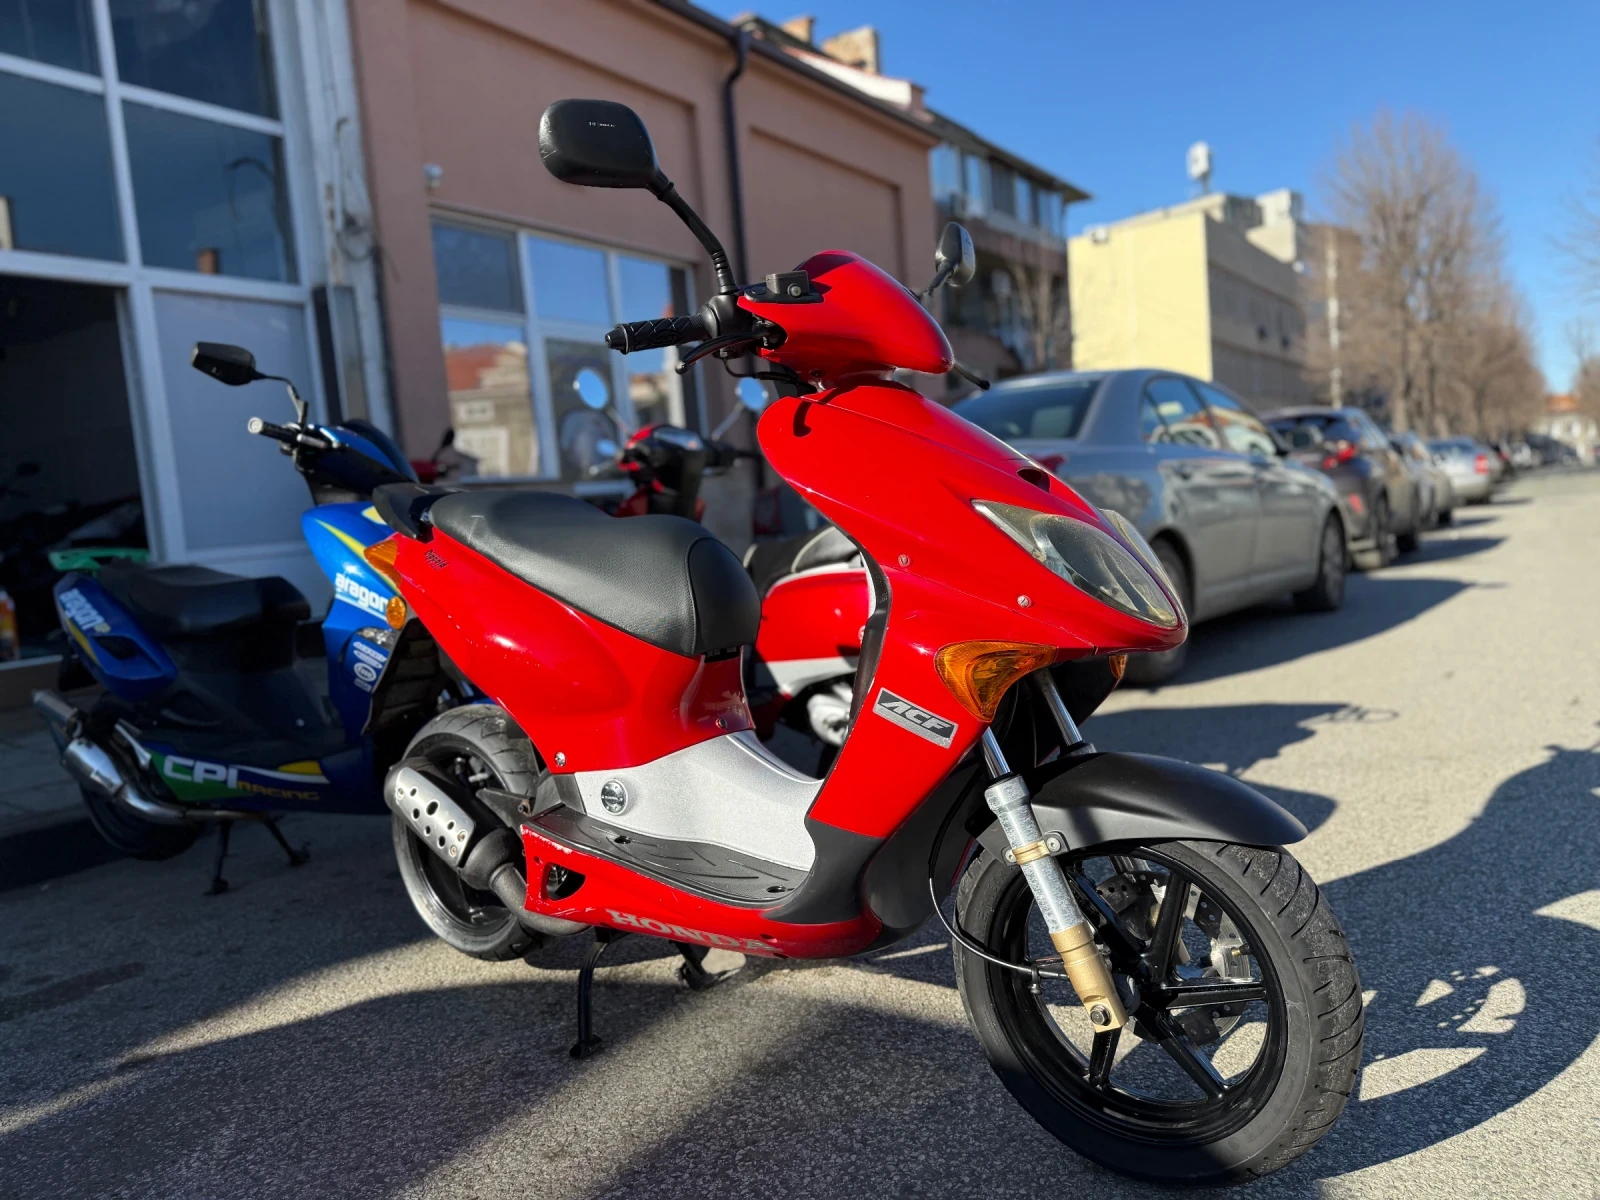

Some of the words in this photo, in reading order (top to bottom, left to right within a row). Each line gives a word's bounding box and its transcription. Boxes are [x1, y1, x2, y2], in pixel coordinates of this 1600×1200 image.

[880, 700, 952, 730] ACF
[163, 754, 239, 789] CPI
[237, 780, 320, 801] RACING
[605, 908, 783, 953] HONDA
